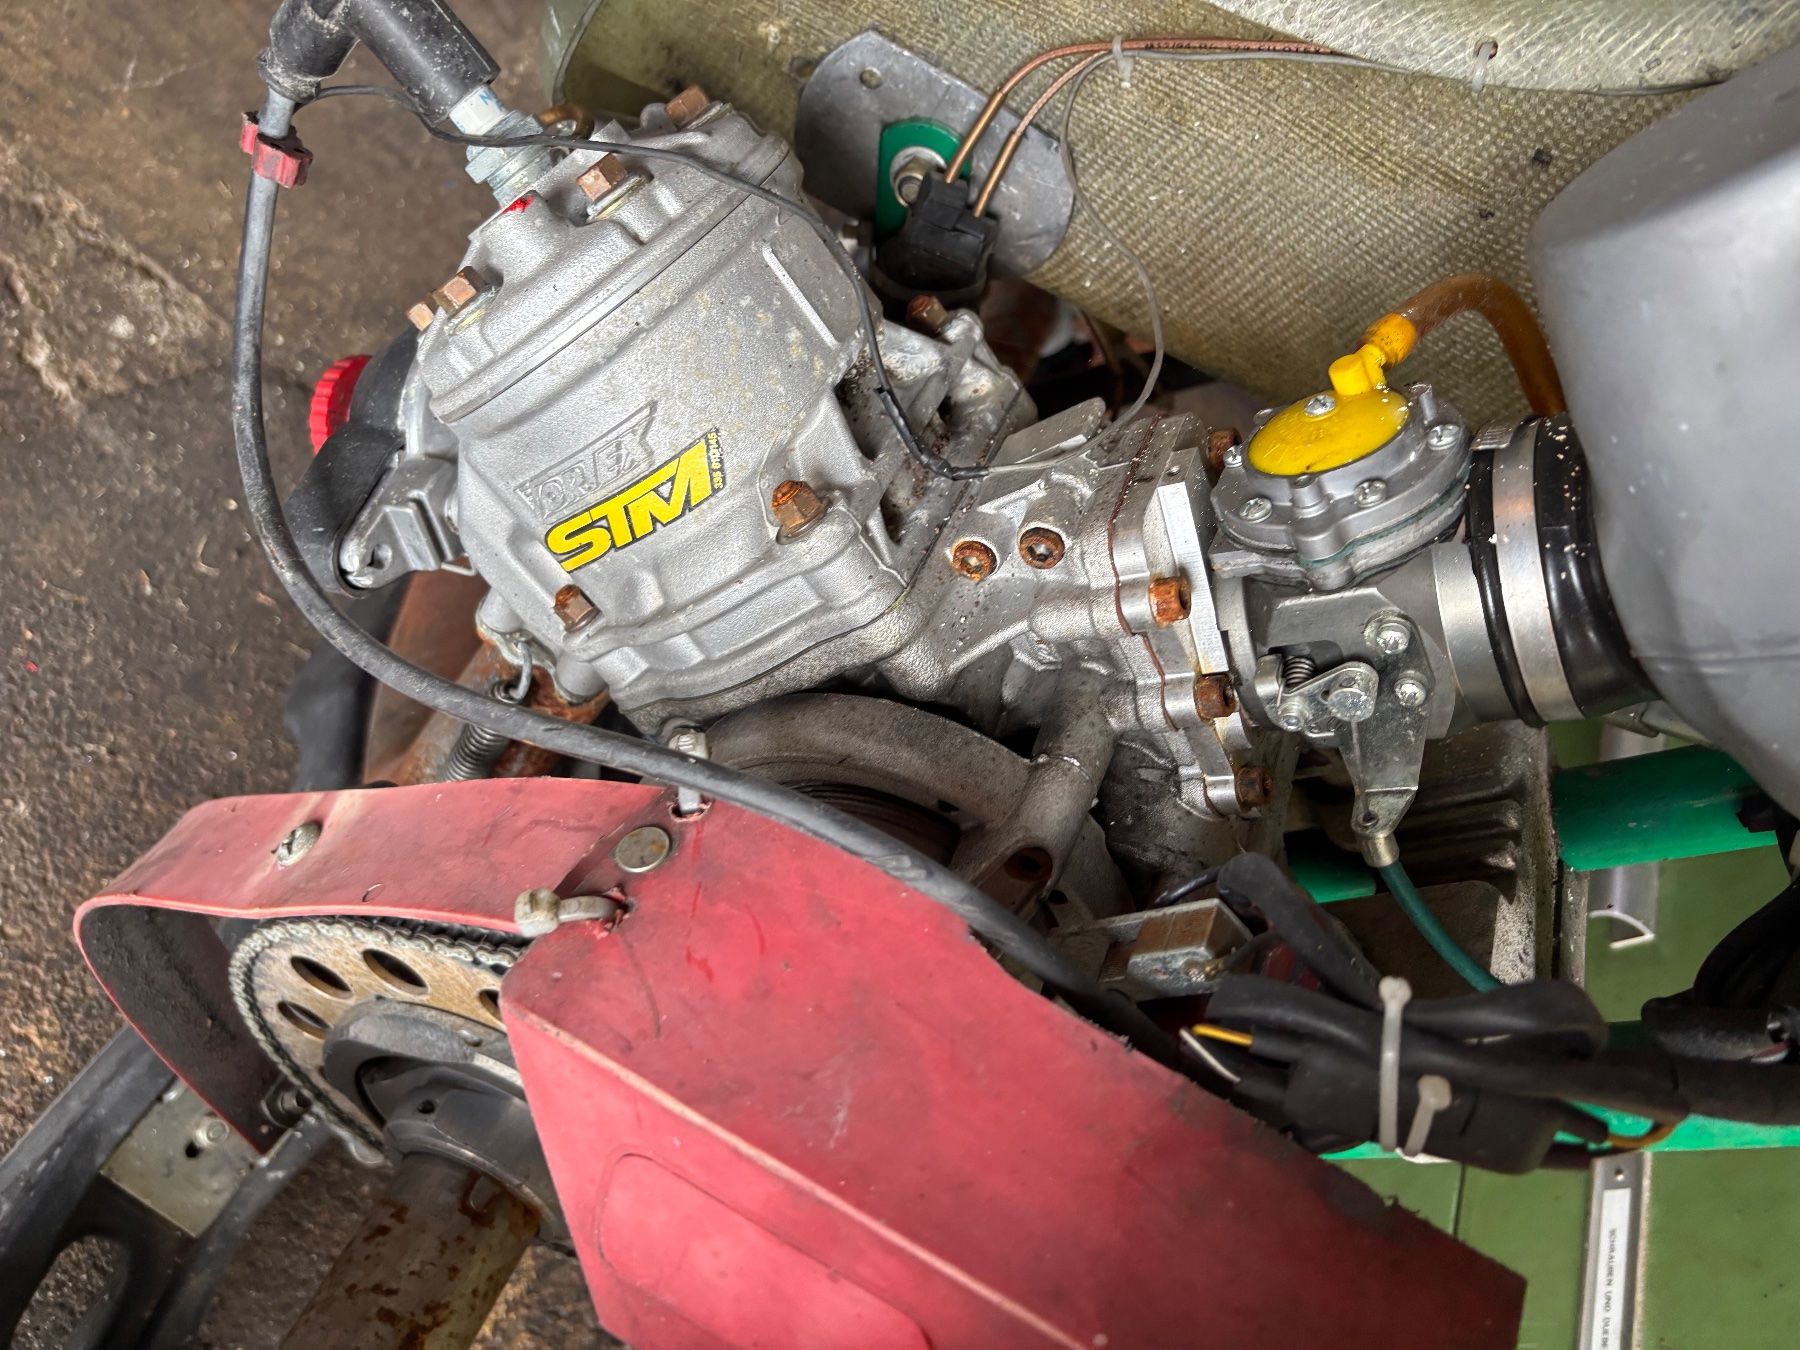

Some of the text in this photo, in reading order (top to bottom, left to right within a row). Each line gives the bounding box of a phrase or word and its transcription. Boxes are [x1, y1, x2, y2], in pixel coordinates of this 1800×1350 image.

[546, 438, 712, 572] STM
[1606, 1228, 1617, 1287] SCHRAUBEN
[1604, 1291, 1613, 1312] UND
